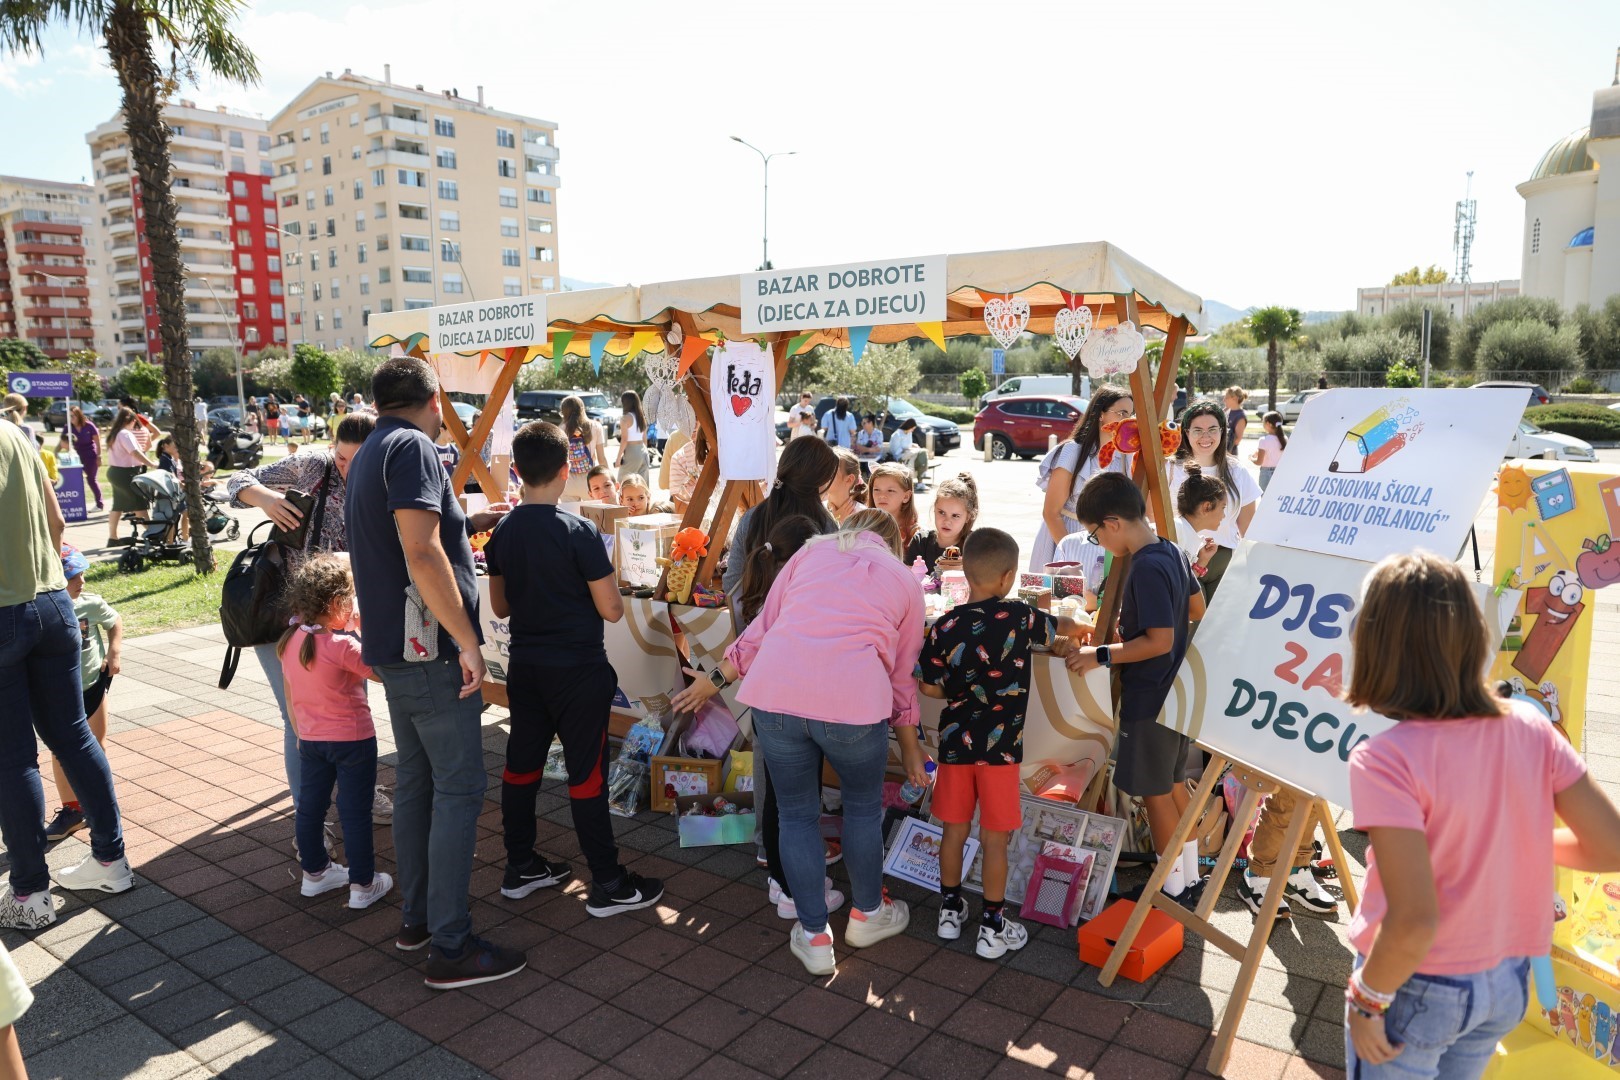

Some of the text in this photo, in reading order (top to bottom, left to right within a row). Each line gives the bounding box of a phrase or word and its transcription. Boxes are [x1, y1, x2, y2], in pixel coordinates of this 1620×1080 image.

[758, 264, 925, 296] BAZAR DOBROTE
[438, 303, 534, 326] BAZAR DOBROTE
[757, 291, 926, 325] (DJECA ZA DJECU)
[438, 323, 535, 348] (DJECA ZA DJECU)
[1300, 475, 1433, 507] JU OSNOVNA ŠKOLA
[1319, 501, 1364, 523] JOKOV
[1327, 524, 1359, 546] BAR
[1249, 574, 1361, 639] DJE
[489, 620, 510, 635] PO
[1274, 641, 1344, 698] ZA
[1224, 678, 1370, 762] DJECU
